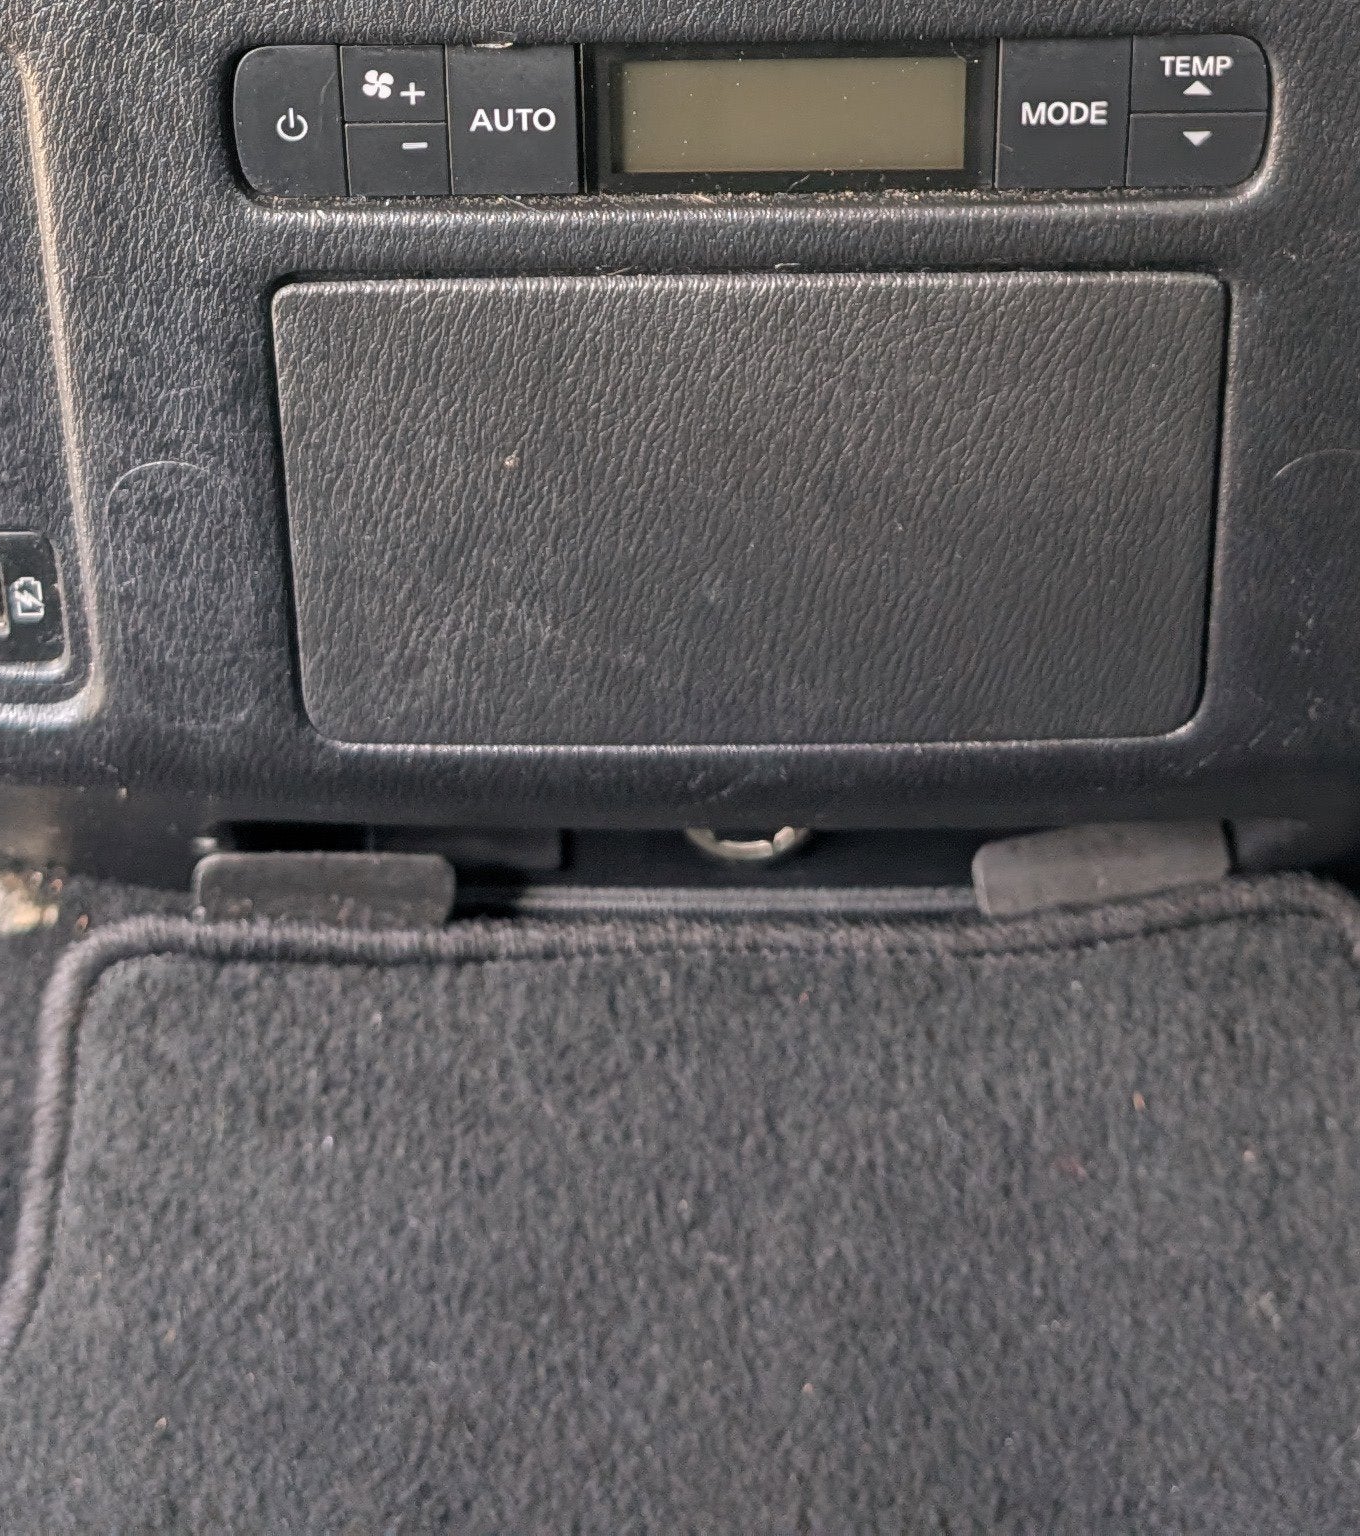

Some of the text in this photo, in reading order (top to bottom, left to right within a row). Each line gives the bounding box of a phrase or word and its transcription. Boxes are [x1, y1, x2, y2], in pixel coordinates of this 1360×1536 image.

[1160, 55, 1234, 77] TEMP
[470, 107, 557, 133] AUTO
[1021, 101, 1108, 126] MODE
